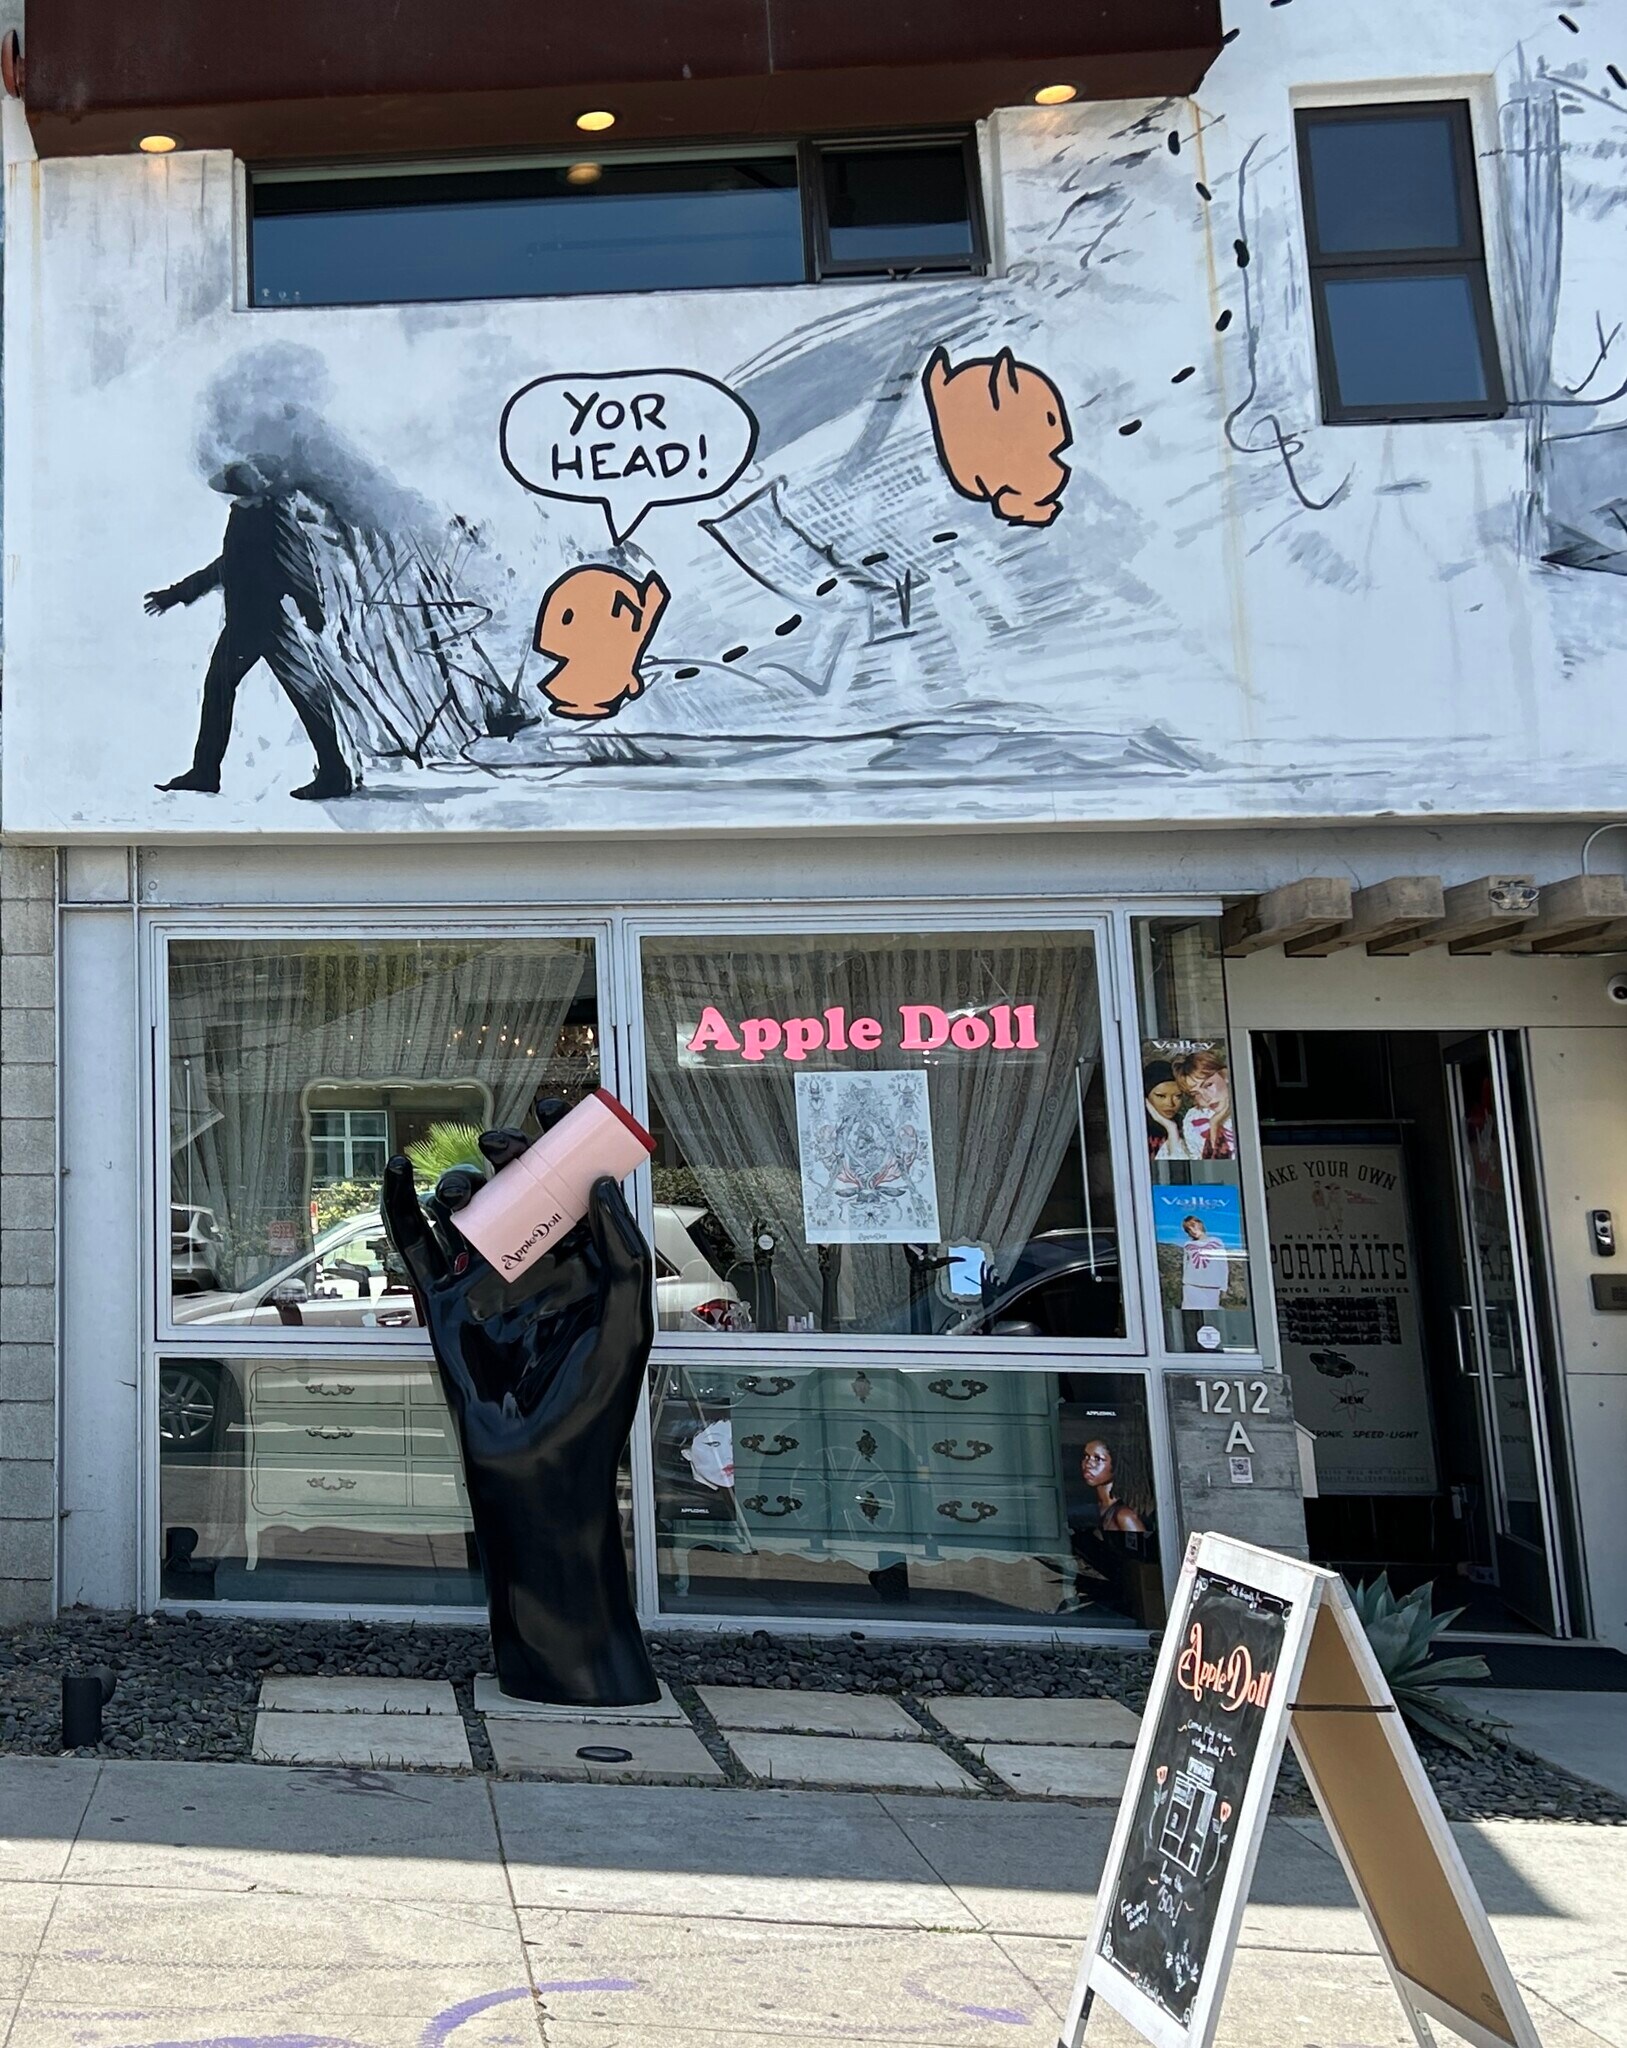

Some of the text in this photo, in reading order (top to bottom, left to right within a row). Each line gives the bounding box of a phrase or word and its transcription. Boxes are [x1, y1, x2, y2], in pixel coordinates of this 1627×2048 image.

[563, 391, 667, 436] YOR
[552, 434, 707, 480] HEAD!
[687, 1004, 1039, 1061] Apple Doll
[1264, 1160, 1397, 1191] AKE YOUR OWN
[1270, 1243, 1407, 1280] PORTRAITS
[1195, 1380, 1271, 1414] 1212
[1340, 1396, 1365, 1405] NEW
[1225, 1421, 1256, 1454] A
